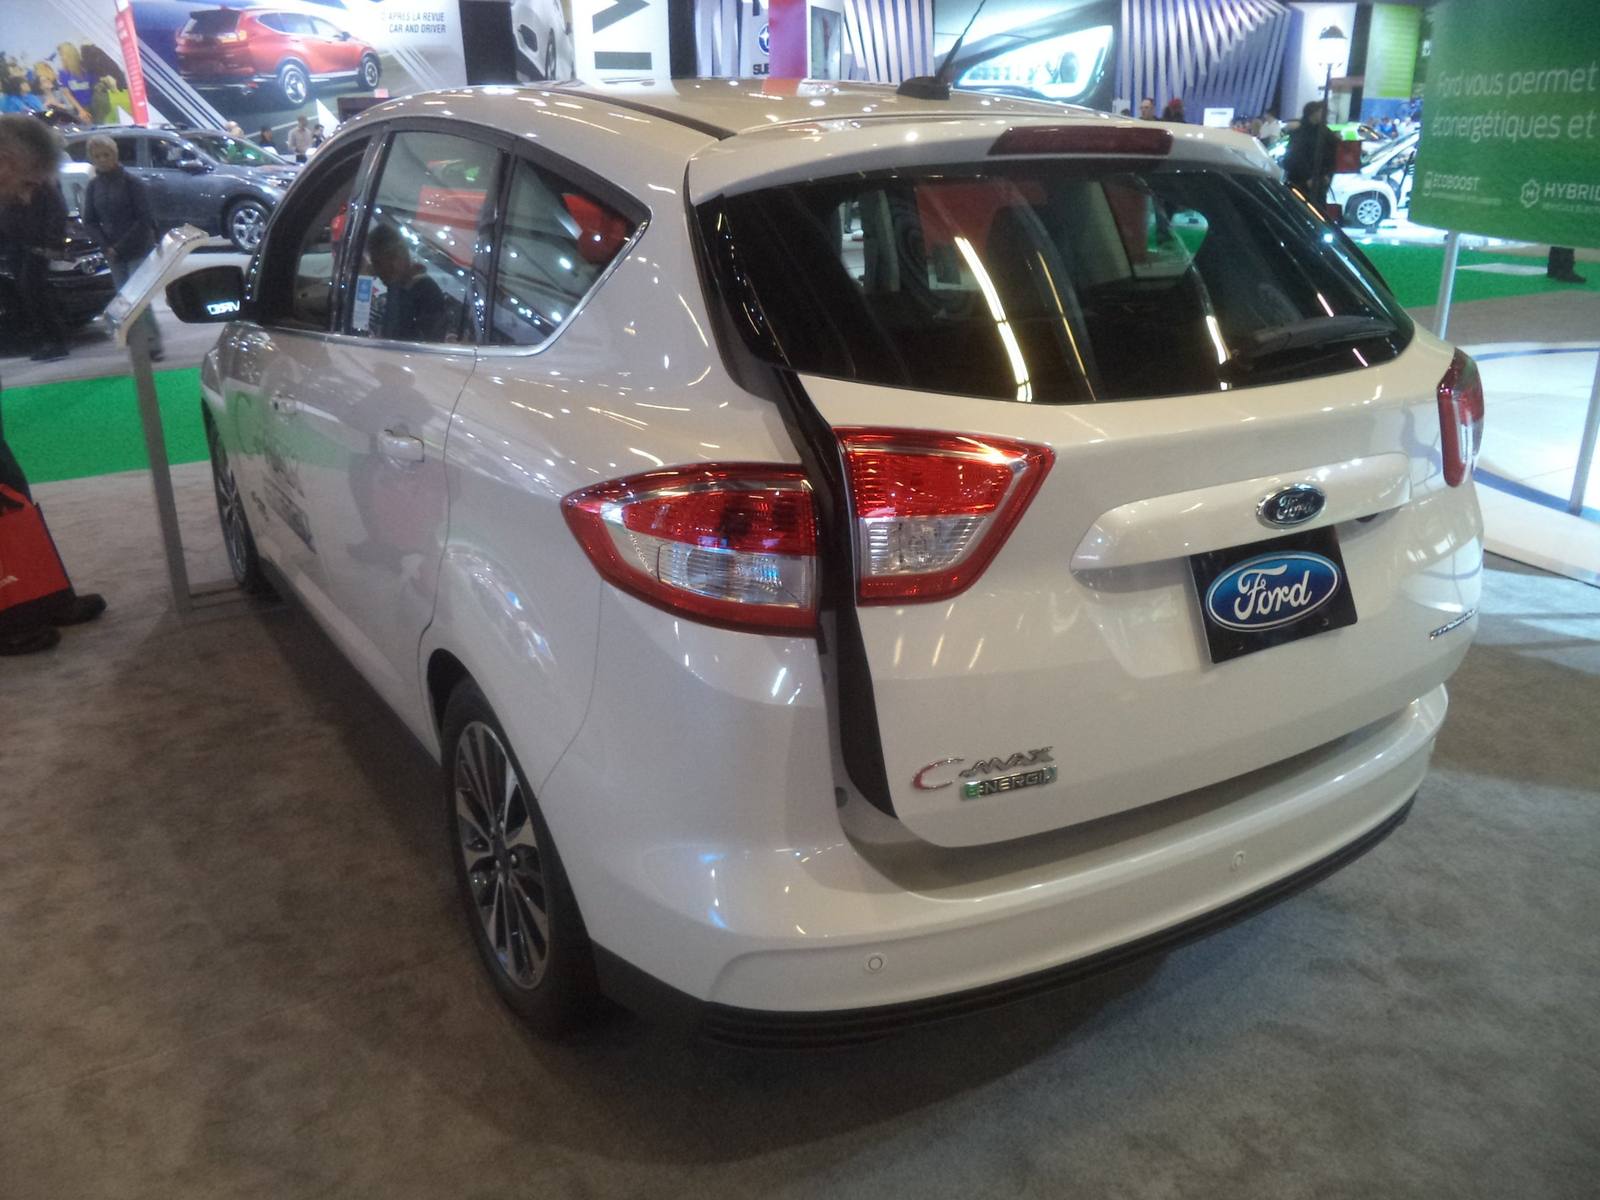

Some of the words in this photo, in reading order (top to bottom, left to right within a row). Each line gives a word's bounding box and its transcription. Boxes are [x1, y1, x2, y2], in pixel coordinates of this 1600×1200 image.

[389, 24, 403, 33] CAR
[405, 24, 419, 33] AND
[421, 24, 446, 33] DRIVER
[412, 12, 421, 21] LA
[423, 11, 445, 21] REVUE
[1438, 70, 1463, 98] Ford
[1465, 72, 1504, 97] vous
[1507, 61, 1599, 99] permet
[1568, 110, 1598, 139] et
[1277, 494, 1317, 519] Ford
[1234, 564, 1312, 620] Ford
